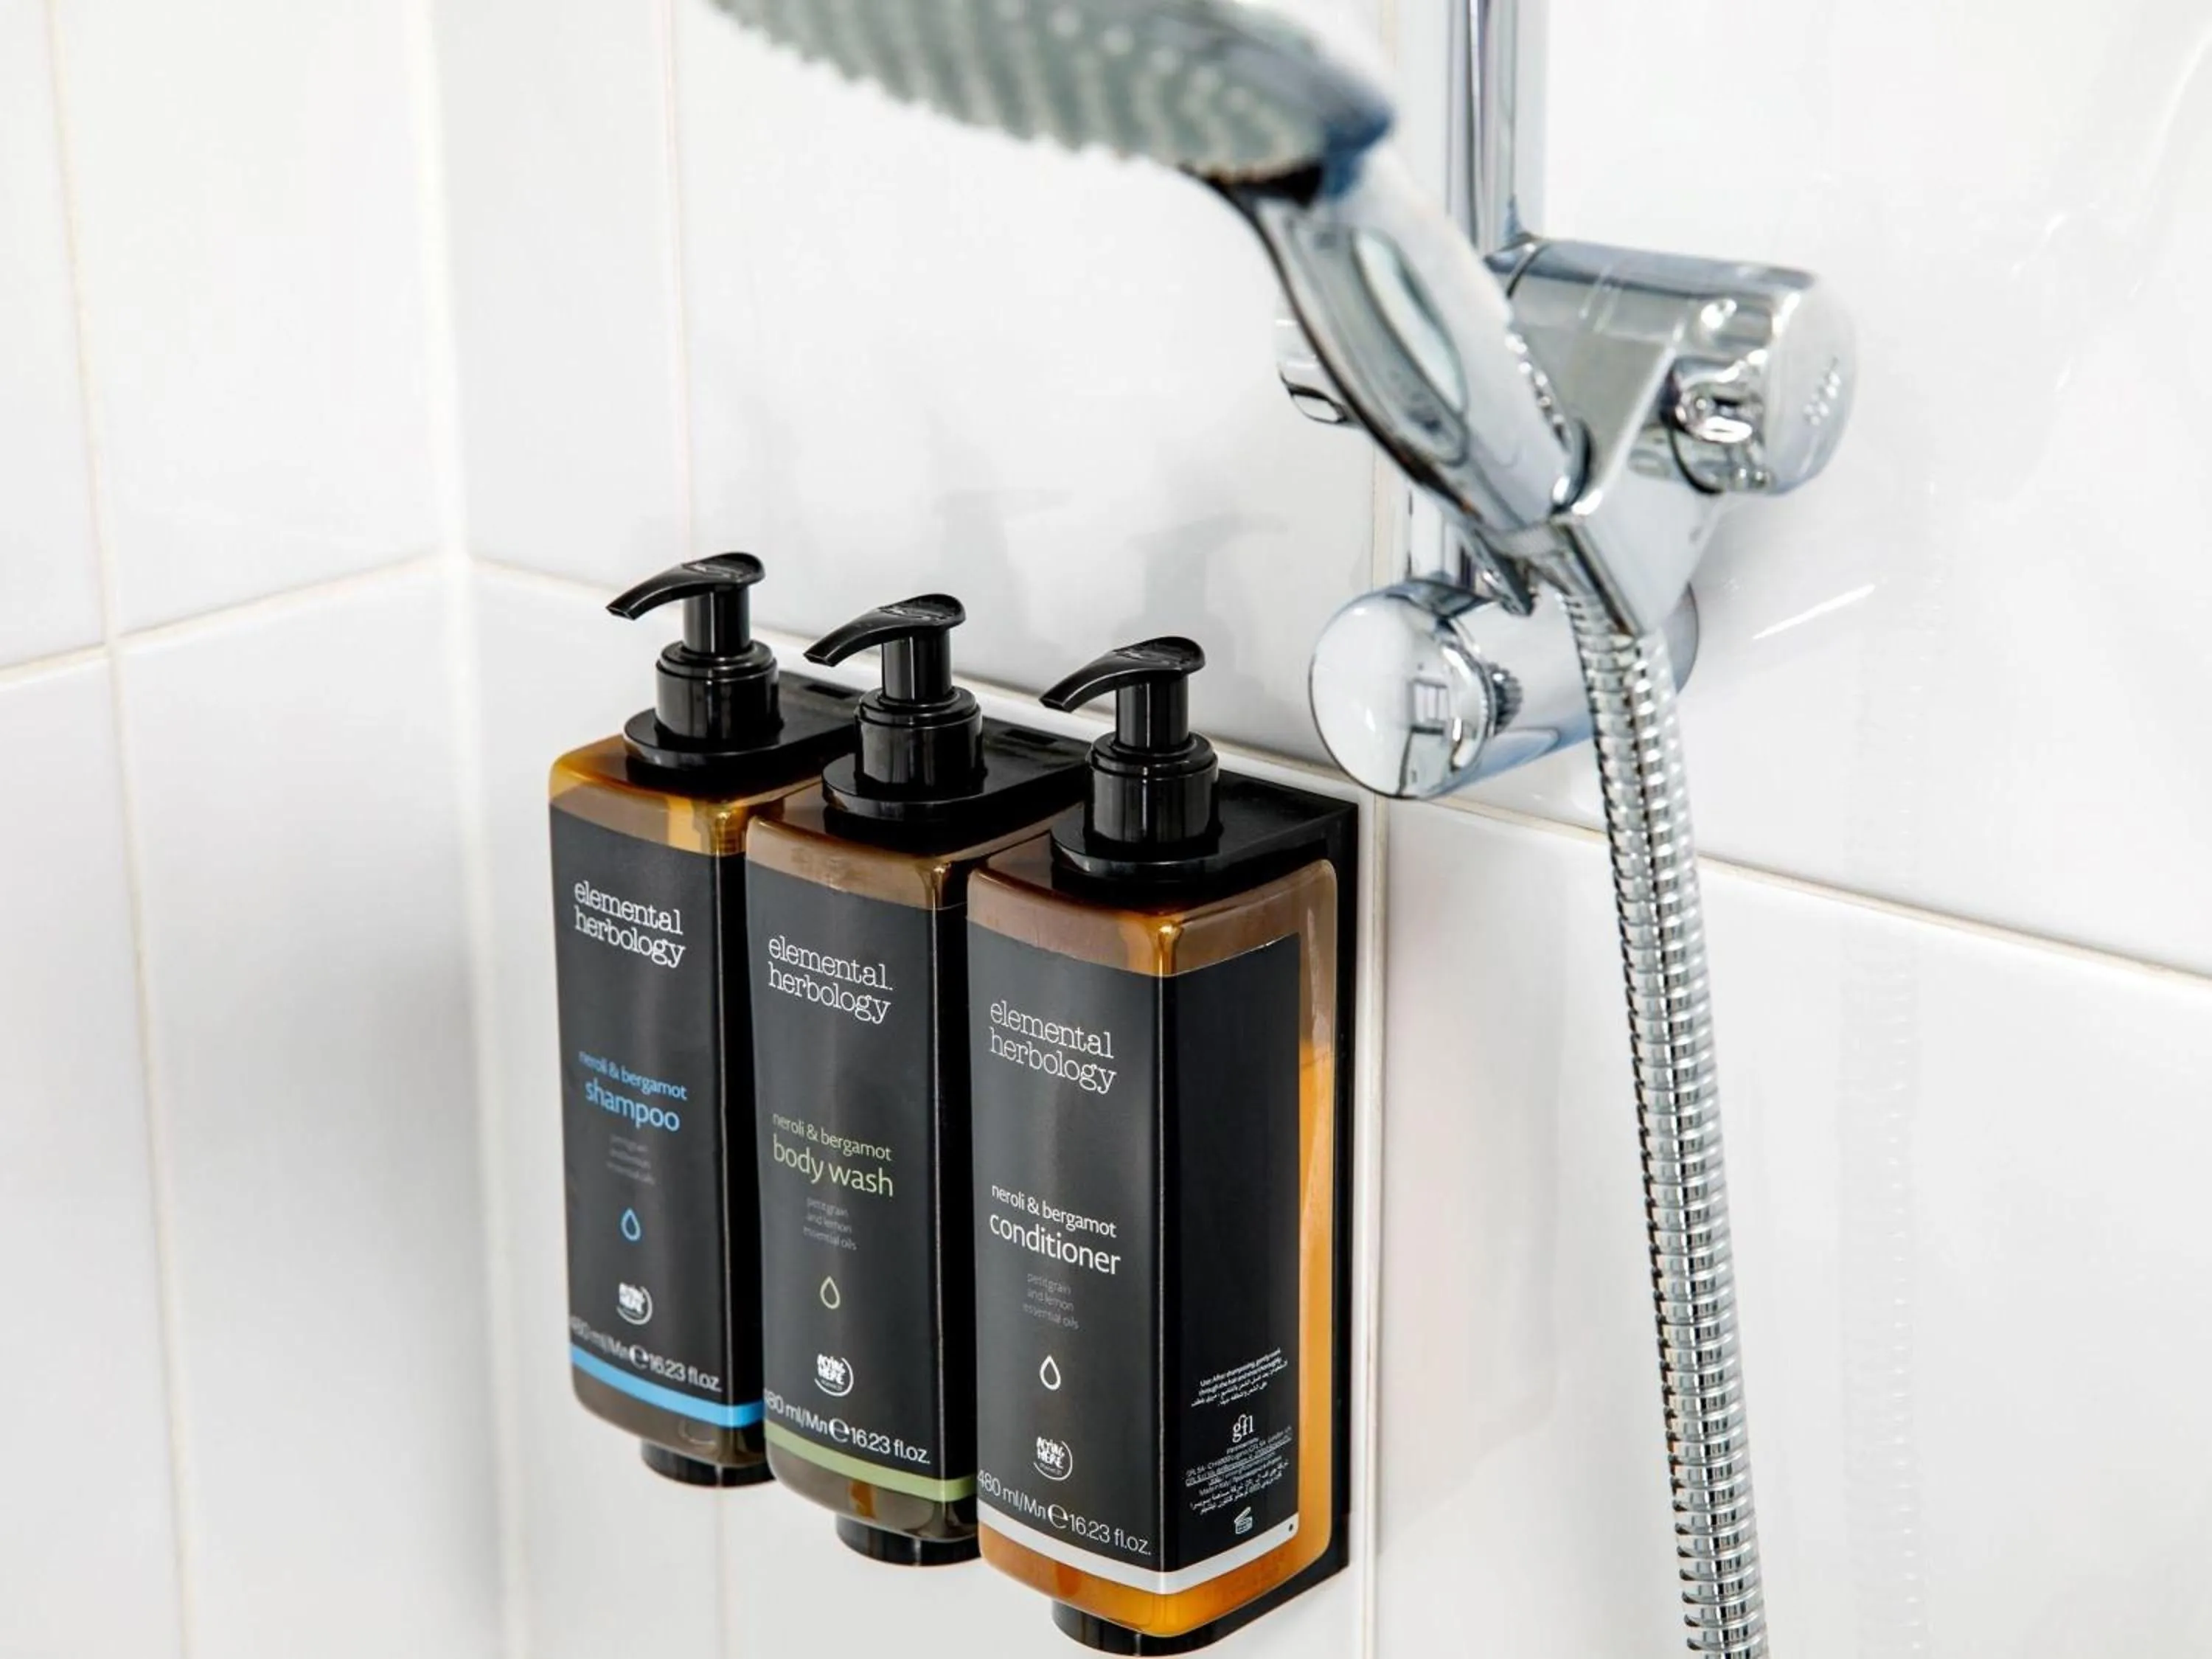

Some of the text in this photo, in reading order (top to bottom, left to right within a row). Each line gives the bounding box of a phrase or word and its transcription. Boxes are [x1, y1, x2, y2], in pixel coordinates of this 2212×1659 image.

[574, 880, 684, 935] elemental
[574, 905, 686, 968] herbology
[768, 961, 891, 1024] herbology
[990, 1000, 1114, 1059] elemental
[609, 1062, 621, 1079] &
[621, 1065, 687, 1101] bergamot
[989, 1026, 1117, 1094] herbology
[585, 1077, 680, 1132] shampoo
[773, 1113, 892, 1161] neroli & bergamot
[773, 1133, 894, 1197] body wash
[992, 1185, 1117, 1238] neroli & bergamot
[990, 1214, 1121, 1275] conditioner
[978, 1470, 1001, 1496] 480
[1069, 1514, 1110, 1543] 16.23
[1113, 1528, 1152, 1556] fl.oz.
